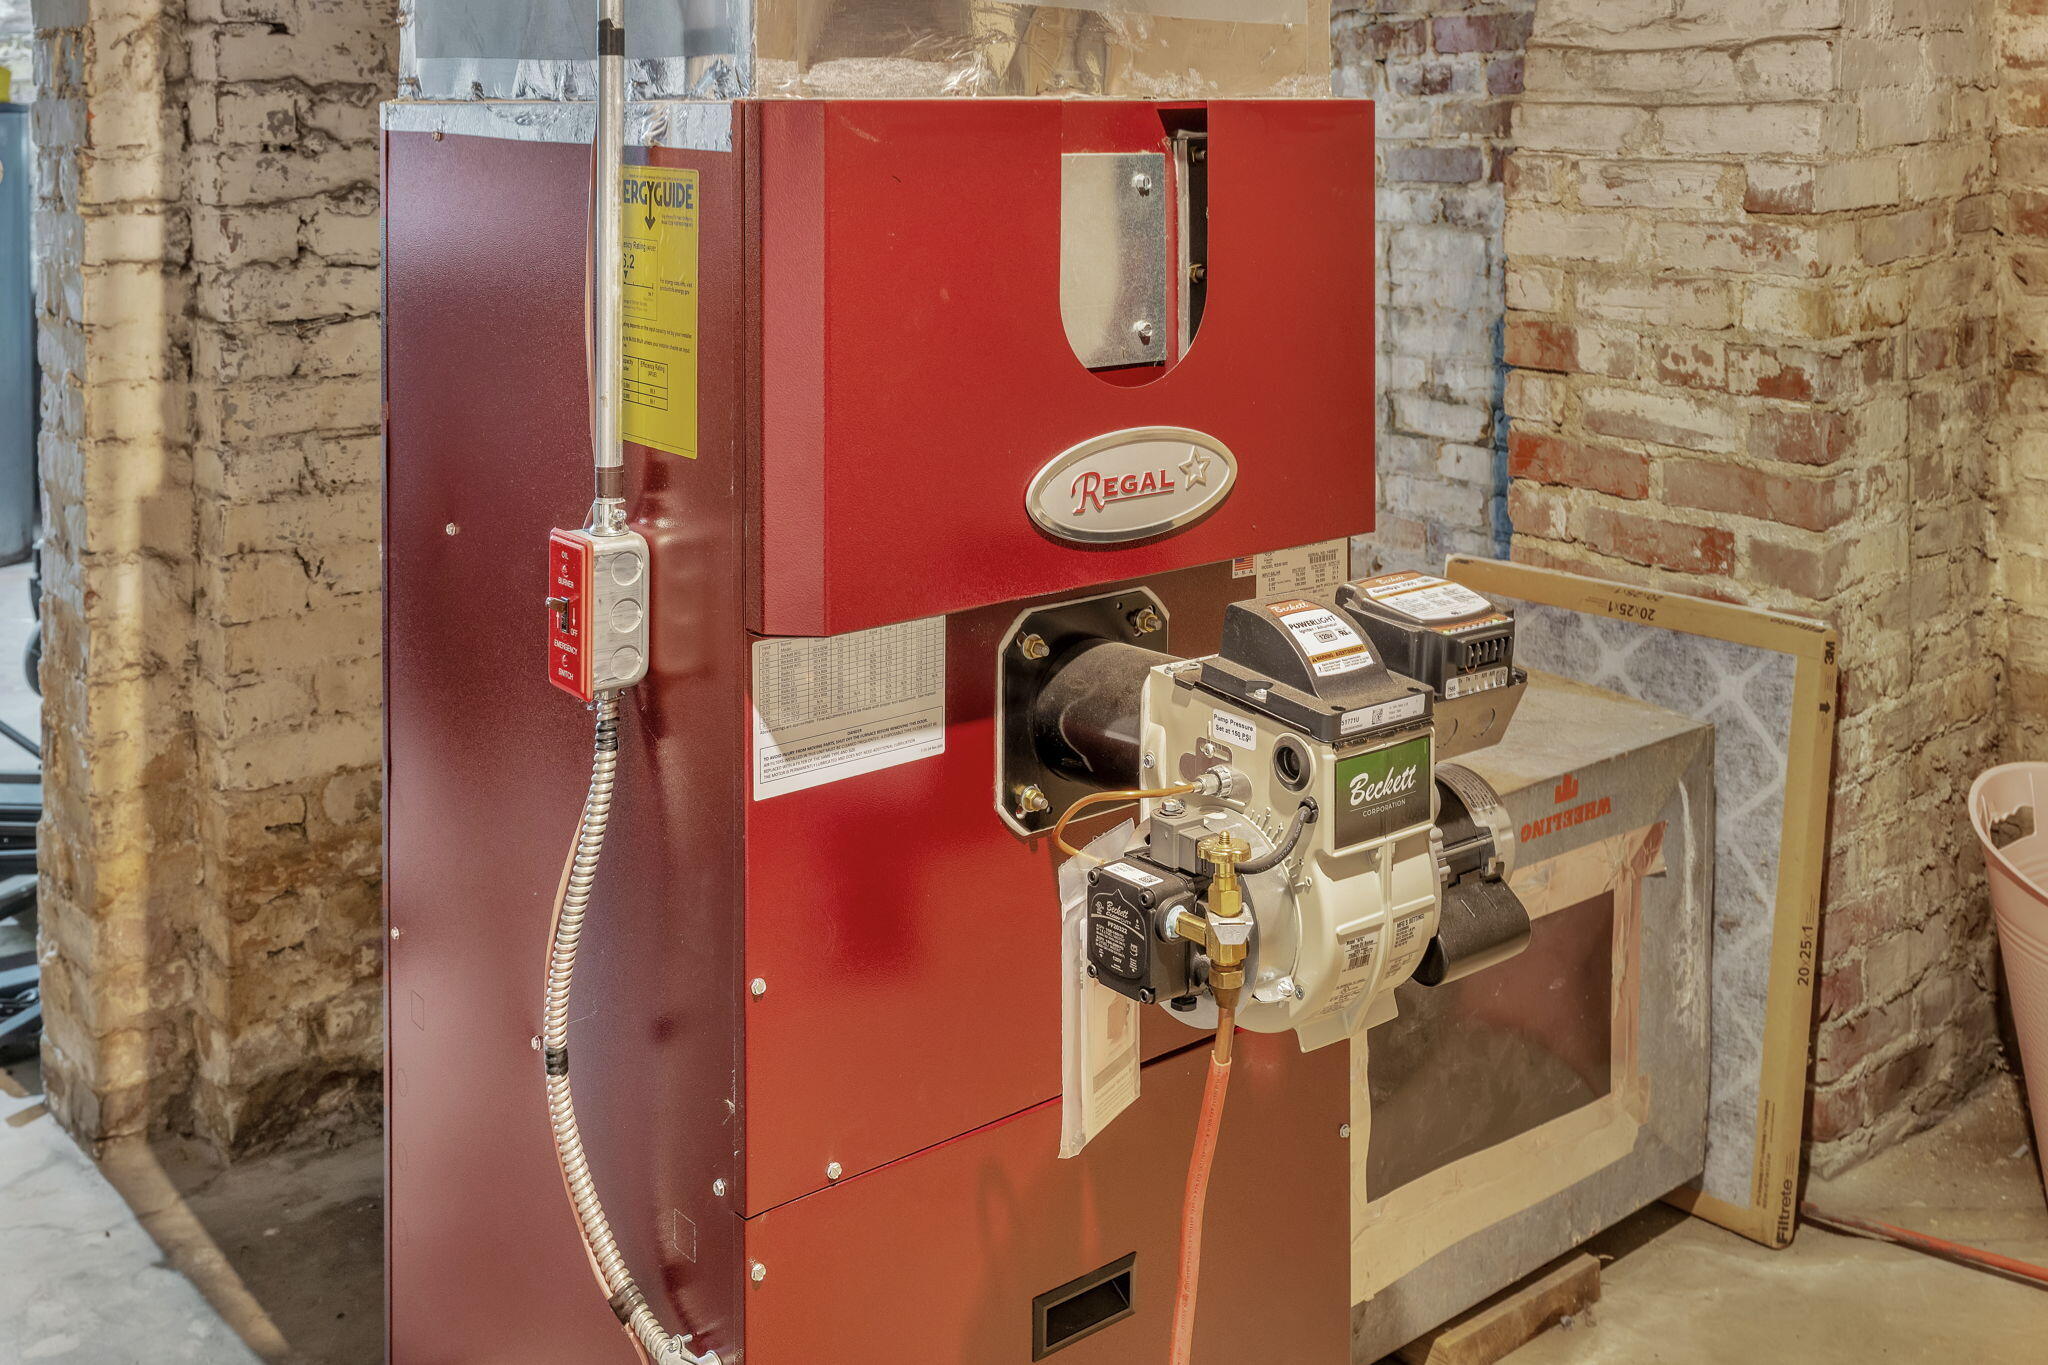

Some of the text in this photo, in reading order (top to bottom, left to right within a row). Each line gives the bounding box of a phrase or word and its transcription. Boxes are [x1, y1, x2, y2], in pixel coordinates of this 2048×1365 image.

[624, 180, 693, 209] ERGYGUIDE
[1071, 469, 1175, 516] REGAL
[557, 577, 575, 589] BURNER
[1608, 601, 1656, 621] 20x25x1
[1288, 615, 1336, 630] POWERLIGHT
[570, 628, 578, 637] OFF
[553, 638, 578, 655] EMERGENCY
[1824, 641, 1835, 665] 3M
[558, 668, 574, 680] SWITCH
[1213, 713, 1253, 732] Pump Pressure
[1216, 724, 1224, 732] Set
[769, 753, 781, 761] AVOID
[1349, 764, 1417, 806] Beckett
[1362, 798, 1406, 817] CORPORATION
[1521, 796, 1612, 843] WHEELING
[1106, 900, 1129, 919] Beckett
[1797, 925, 1813, 986] 20x25x1
[1776, 1178, 1793, 1244] Filtrete
